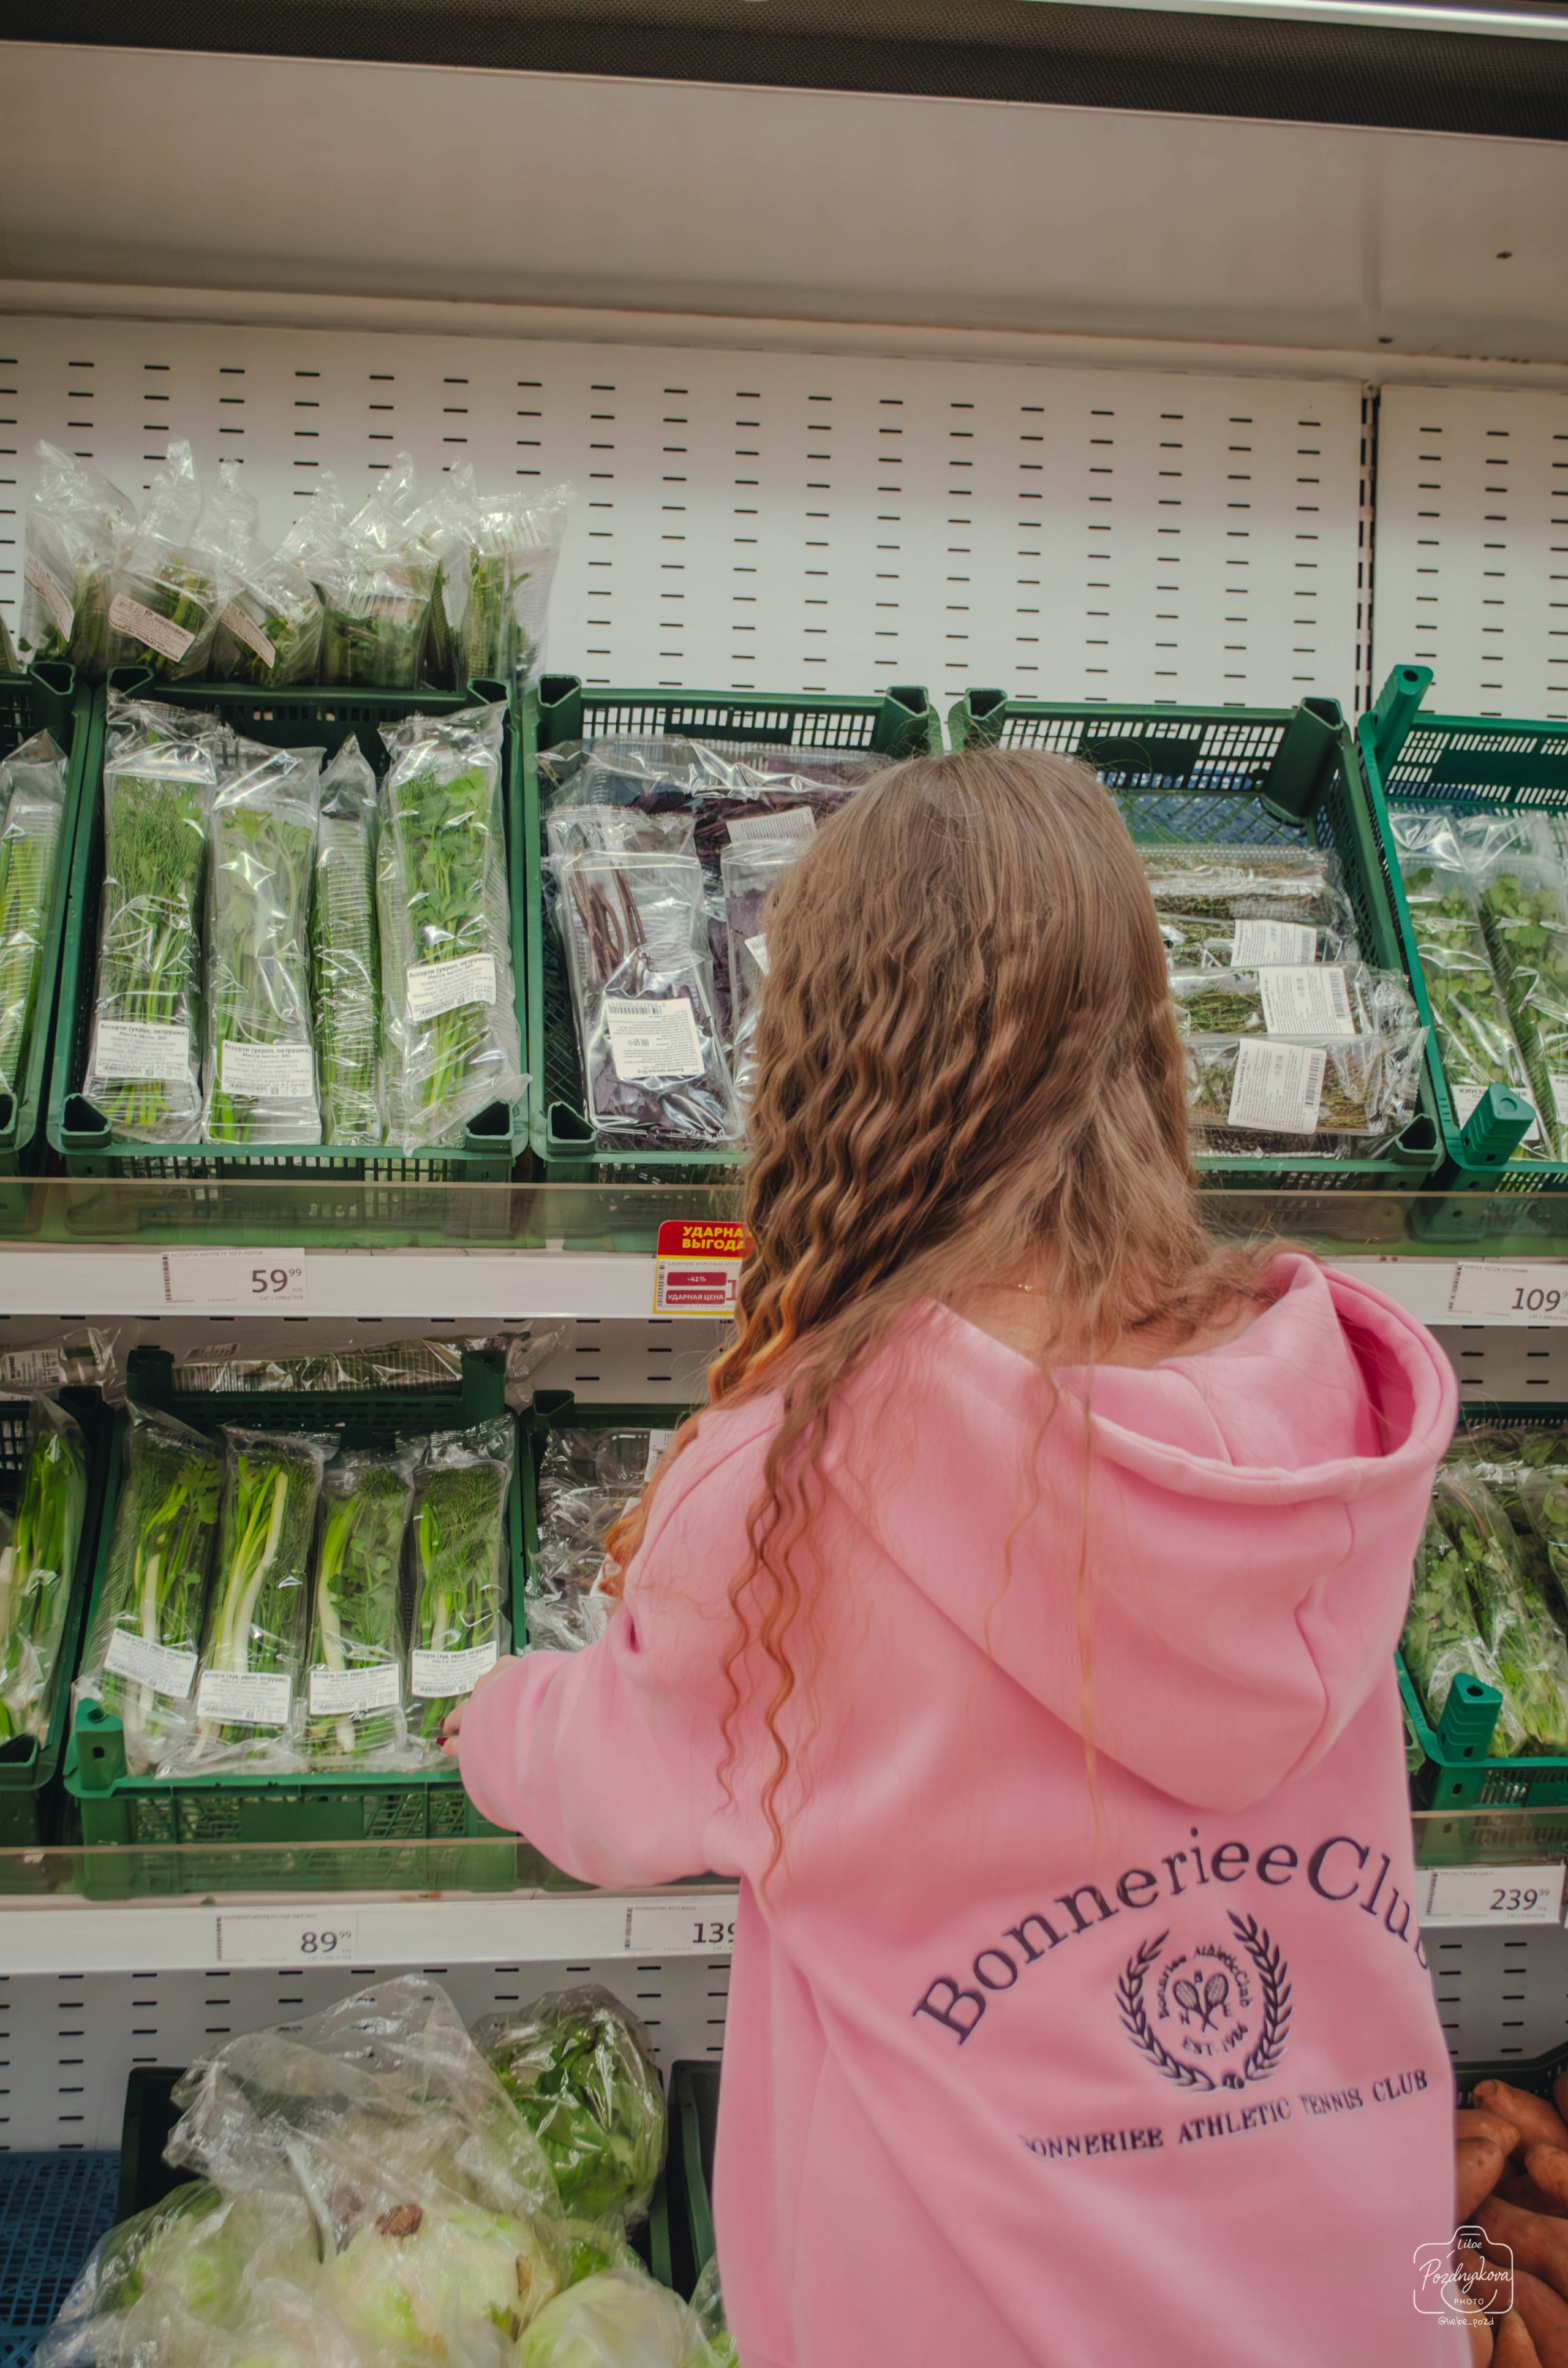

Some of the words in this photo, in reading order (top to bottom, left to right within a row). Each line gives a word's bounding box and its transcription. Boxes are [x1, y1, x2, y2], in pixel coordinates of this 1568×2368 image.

[224, 1043, 249, 1052] Ассорти
[683, 1227, 752, 1238] УДАРНА
[252, 1269, 288, 1293] 59
[1512, 1288, 1561, 1312] 109
[1490, 1888, 1537, 1910] 239
[301, 1932, 337, 1953] 89
[1017, 2127, 1164, 2158] ONNERIEE
[1178, 2098, 1291, 2144] ATHLETIC
[1300, 2088, 1363, 2116] TENNIS
[1372, 2069, 1428, 2102] CLUB
